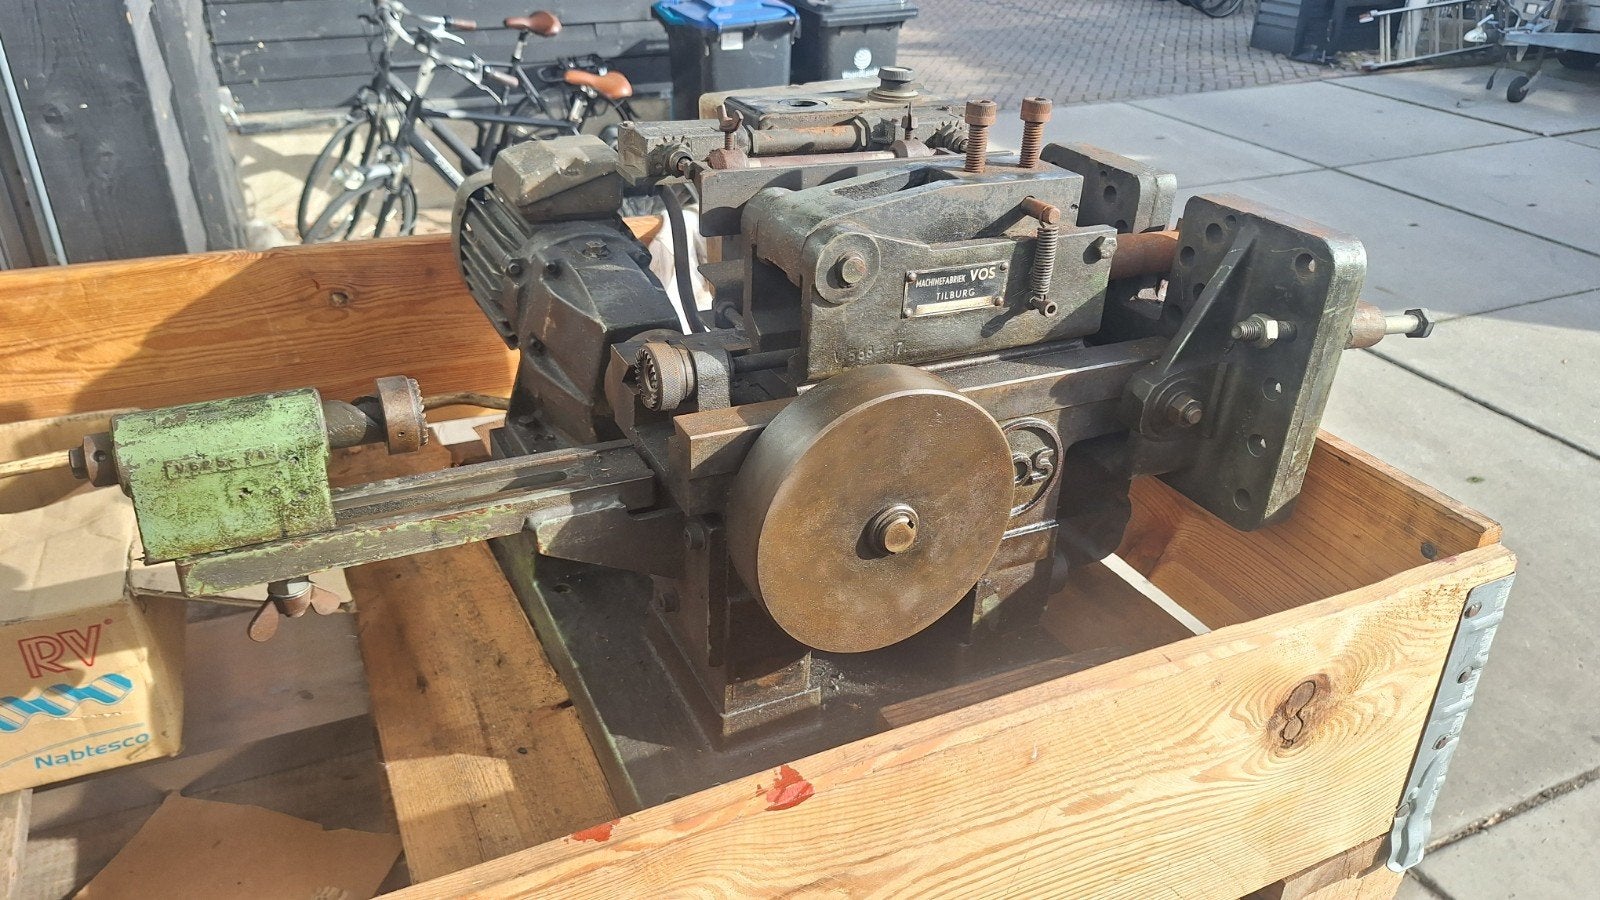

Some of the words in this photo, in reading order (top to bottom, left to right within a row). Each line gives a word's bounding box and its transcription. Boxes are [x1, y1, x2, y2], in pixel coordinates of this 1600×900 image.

[915, 274, 967, 288] MACHINEFABRIEK
[970, 266, 996, 281] VOS
[936, 288, 976, 301] TILBURG
[1012, 446, 1054, 488] OS
[34, 733, 150, 769] Nabtesco
